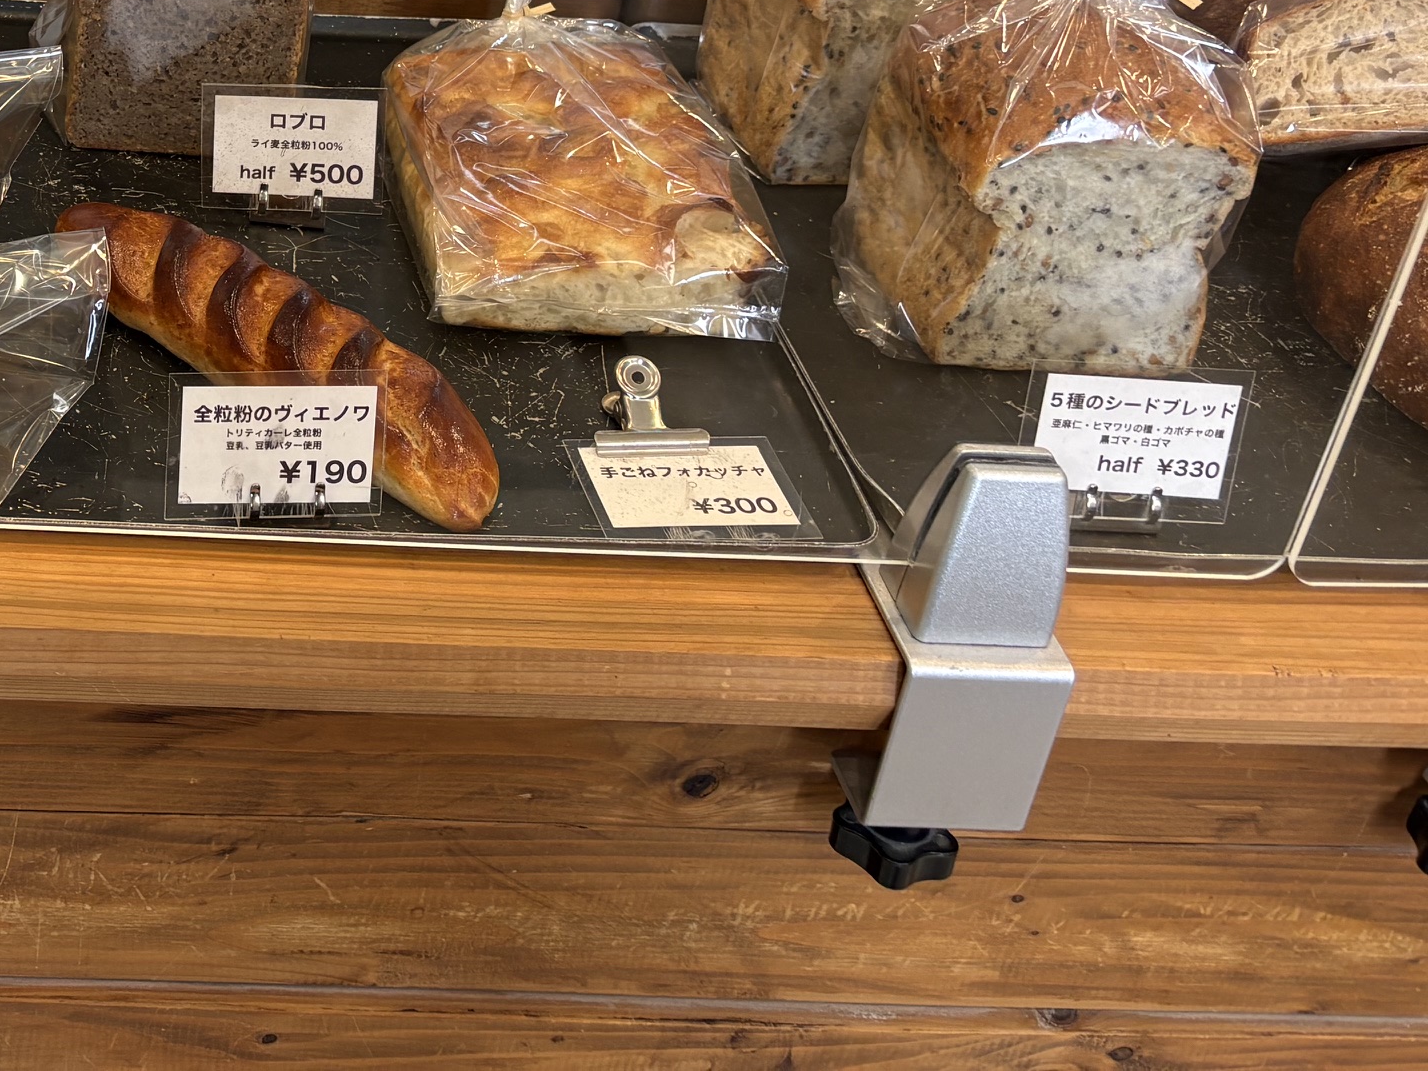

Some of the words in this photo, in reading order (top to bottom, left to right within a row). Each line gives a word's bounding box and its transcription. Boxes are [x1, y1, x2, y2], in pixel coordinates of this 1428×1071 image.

[270, 112, 326, 131] ロブロ
[251, 138, 343, 152] ライ麦全粒粉100%
[239, 164, 276, 180] half
[289, 162, 364, 185] ¥500
[193, 405, 370, 424] 全粒粉のヴィエノワ
[1050, 391, 1237, 420] 5種のシードブレッド
[226, 428, 322, 438] トリティカーレ全粒粉
[1099, 434, 1171, 448] 黒ゴマ・白ゴマ
[279, 460, 367, 484] ¥190
[600, 465, 766, 479] 手ごねフォカッチャ
[1096, 455, 1144, 474] half
[1157, 458, 1220, 479] ¥330
[692, 496, 778, 515] ¥300
